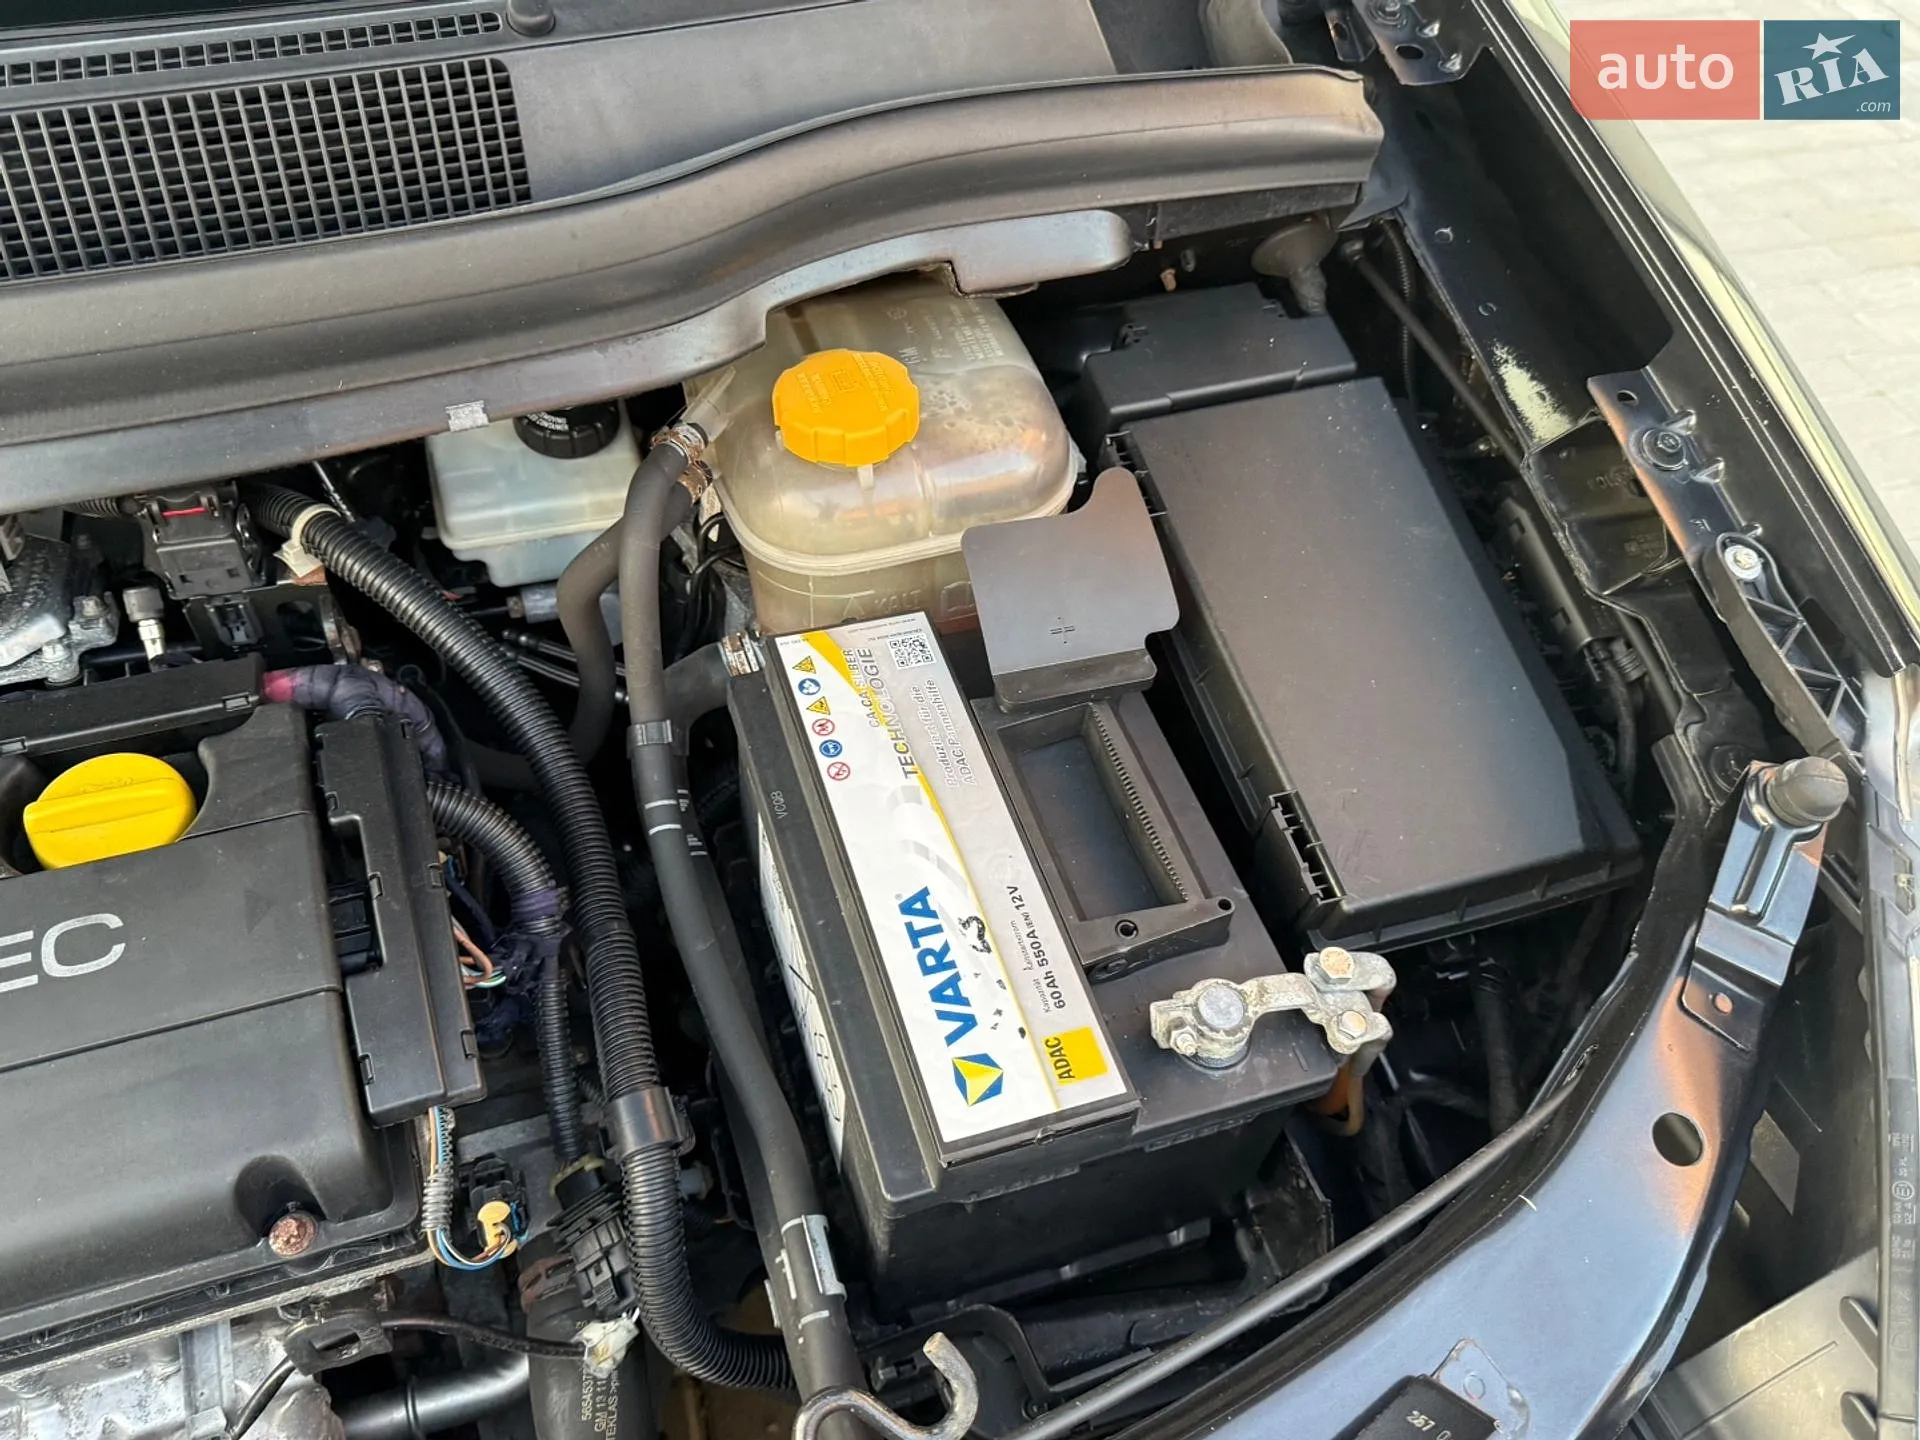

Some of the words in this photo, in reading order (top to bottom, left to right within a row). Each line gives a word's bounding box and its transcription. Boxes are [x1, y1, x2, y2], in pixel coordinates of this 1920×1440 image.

[857, 648, 919, 779] TECHNOLOGIE
[952, 747, 977, 785] ADAC
[898, 885, 979, 1048] VARTA
[1044, 1036, 1076, 1081] ADAC
[594, 1411, 607, 1432] GM
[605, 1396, 619, 1440] TEKLAS
